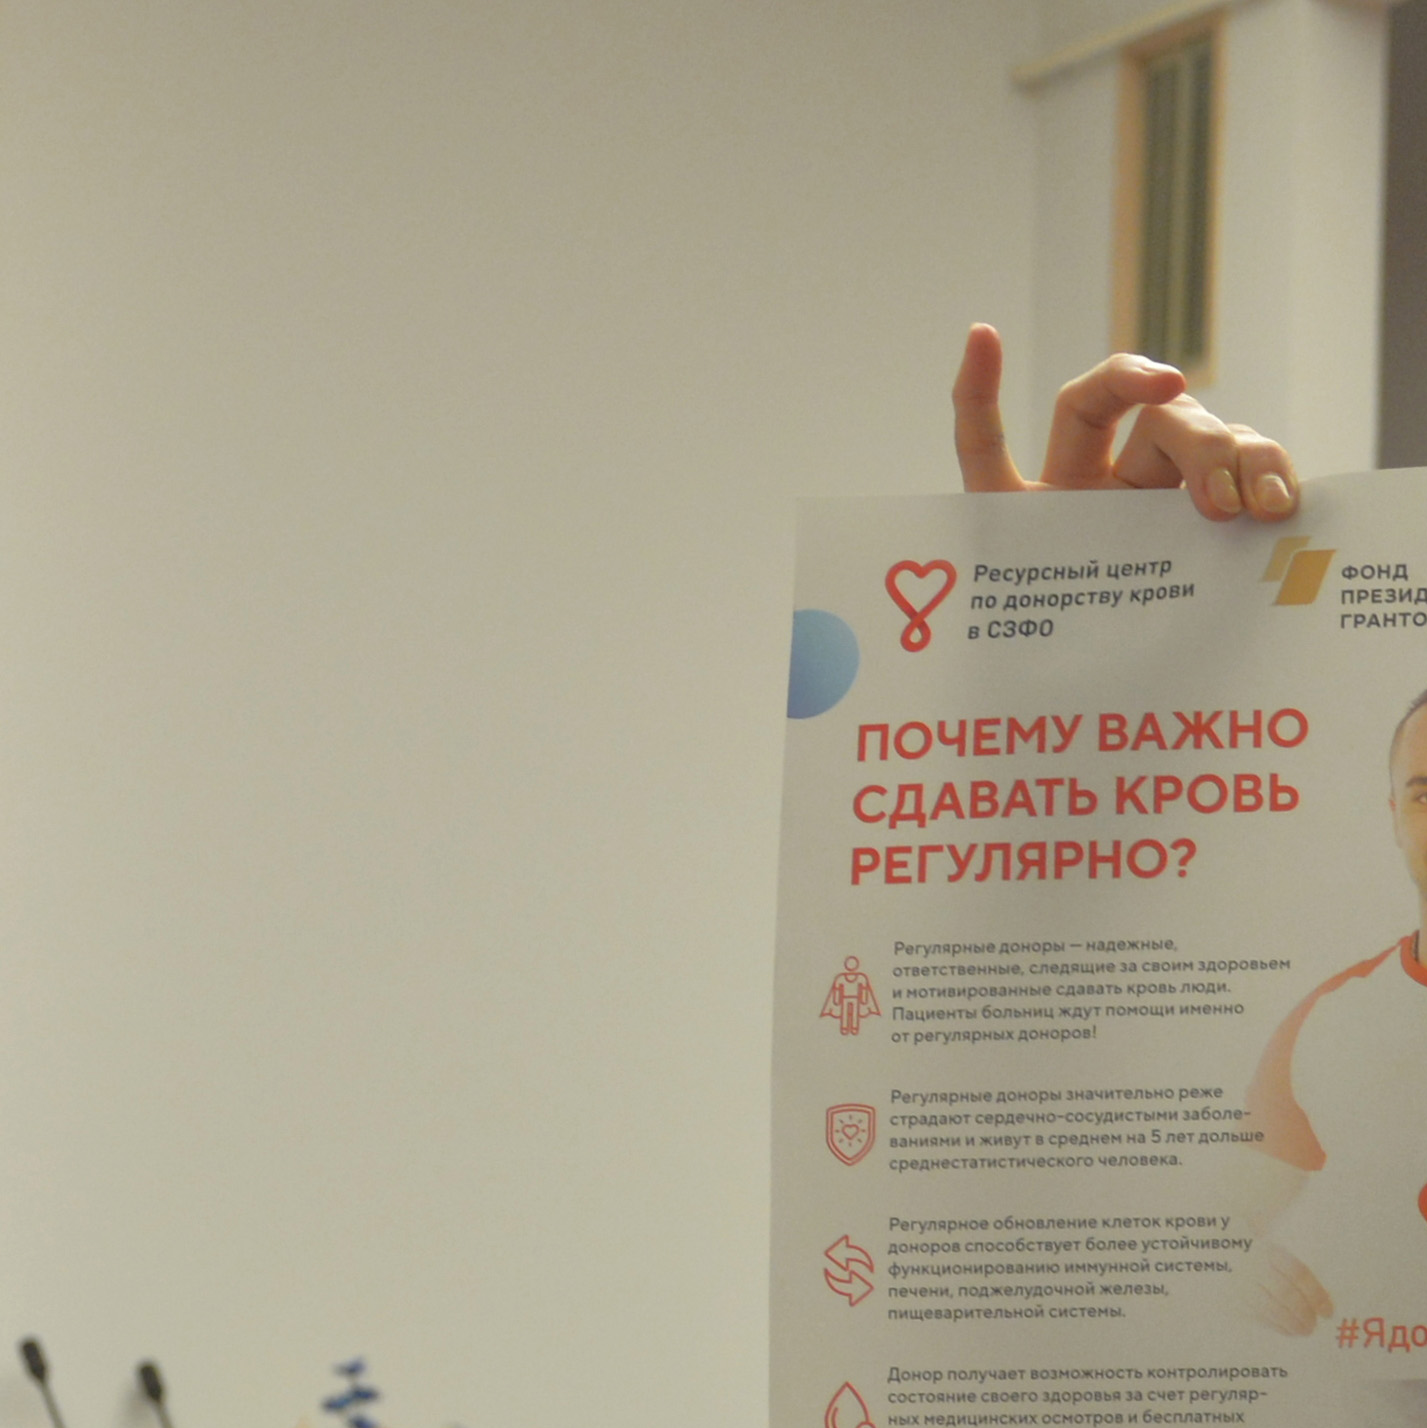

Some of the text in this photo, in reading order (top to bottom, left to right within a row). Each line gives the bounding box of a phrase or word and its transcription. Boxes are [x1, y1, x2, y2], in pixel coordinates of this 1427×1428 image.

[973, 558, 1173, 587] Ресурсный центр
[1341, 563, 1409, 583] ФОНД
[970, 582, 1195, 612] по донорству крови
[967, 618, 1054, 641] в СЗФО
[857, 707, 1309, 763] ПОЧЕМУ ВАЖНО
[852, 772, 1300, 831] СДАВАТЬ КРОВЬ
[850, 836, 1197, 886] РЕГУЛЯРНО?
[893, 939, 996, 959] Регулярные
[998, 941, 1066, 958] доноры
[1085, 938, 1178, 954] надежные,
[892, 958, 1291, 979] ответственные, следящие за своим здоровьем
[892, 981, 1231, 1002] и мотивированные сдавать кровь люди.
[892, 1003, 1245, 1023] Пациенты больниц ждут помощи именно
[890, 1023, 1097, 1047] от регулярных доноров!
[890, 1086, 1224, 1108] Регулярные доноры значительно реже
[889, 1104, 1253, 1130] страдают сердечно-сосудистыми заболе-
[889, 1127, 1265, 1151] ваниями и живут в среднем на 5 лет дольше
[888, 1154, 1183, 1175] среднестатистического человека.
[889, 1214, 1231, 1235] Регулярное обновление клеток крови у
[887, 1234, 1253, 1257] доноров способствует более устойчивому
[887, 1257, 1233, 1280] функционированию иммунной системы,
[888, 1280, 1169, 1301] печени, поджелудочной железы,
[887, 1303, 1126, 1324] пищеварительной системы.
[886, 1365, 1289, 1386] Донор получает возможность контролировать
[887, 1389, 1268, 1407] состояние своего здоровья за счет регуляр-
[887, 1408, 1245, 1428] ных медицинских осмотров и бесплатных
